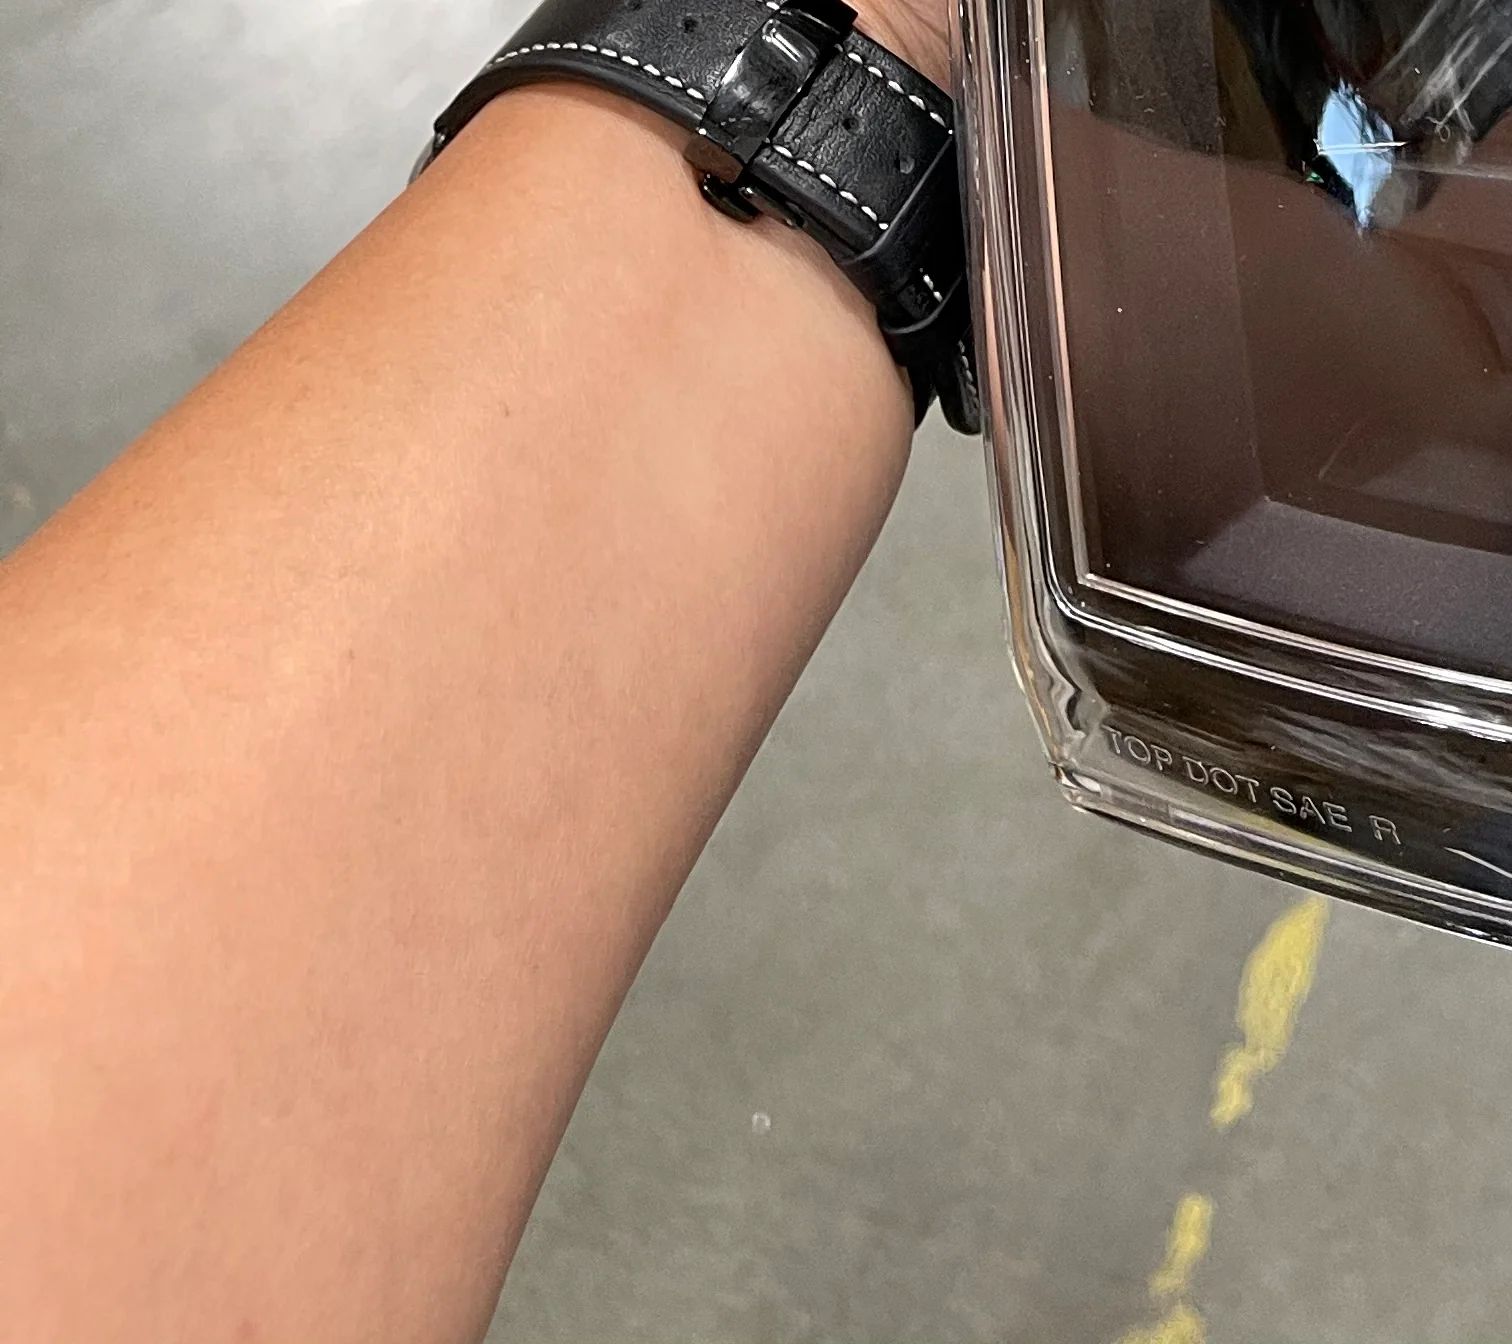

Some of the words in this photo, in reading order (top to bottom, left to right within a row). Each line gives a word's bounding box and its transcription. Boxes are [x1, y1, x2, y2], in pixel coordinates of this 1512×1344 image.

[1103, 725, 1173, 771] TOP
[1182, 755, 1260, 803] DOT
[1269, 786, 1352, 832] SAE
[1368, 814, 1401, 845] R
